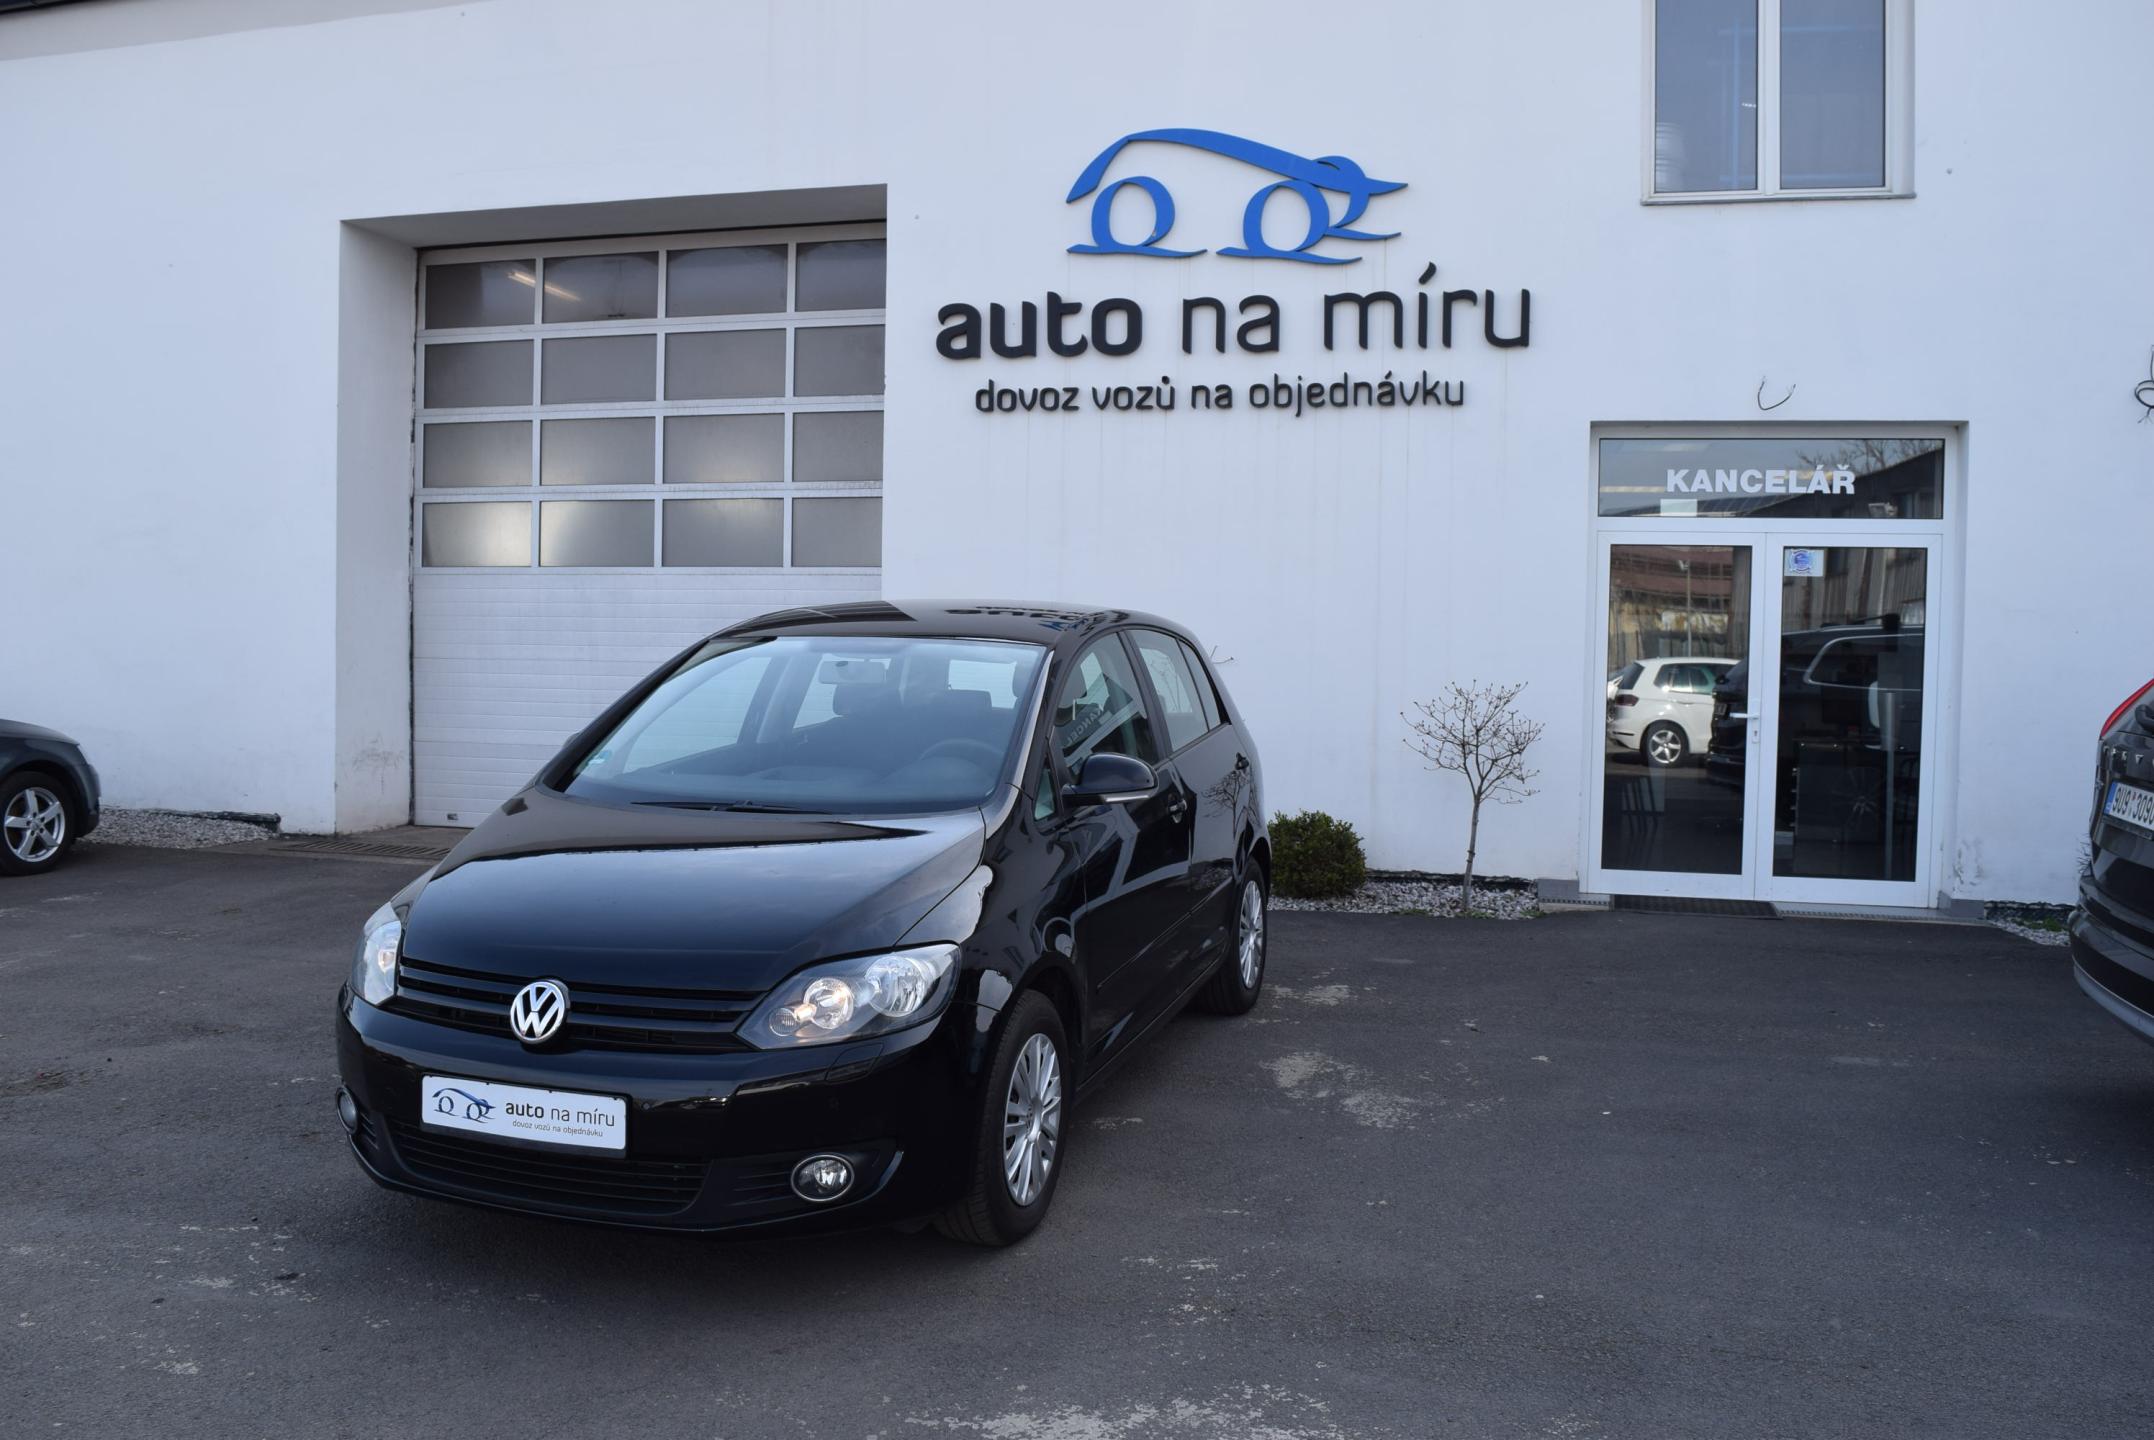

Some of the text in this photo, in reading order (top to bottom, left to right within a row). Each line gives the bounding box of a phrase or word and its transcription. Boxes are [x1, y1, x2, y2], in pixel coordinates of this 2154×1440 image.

[936, 262, 1531, 360] auto na míru
[975, 370, 1464, 418] dovoz vozů na objednávku
[1666, 464, 1855, 495] KANCELÁŘ
[505, 1102, 615, 1127] auto na míru
[512, 1120, 533, 1129] dovoz
[563, 1126, 603, 1137] objednávku
